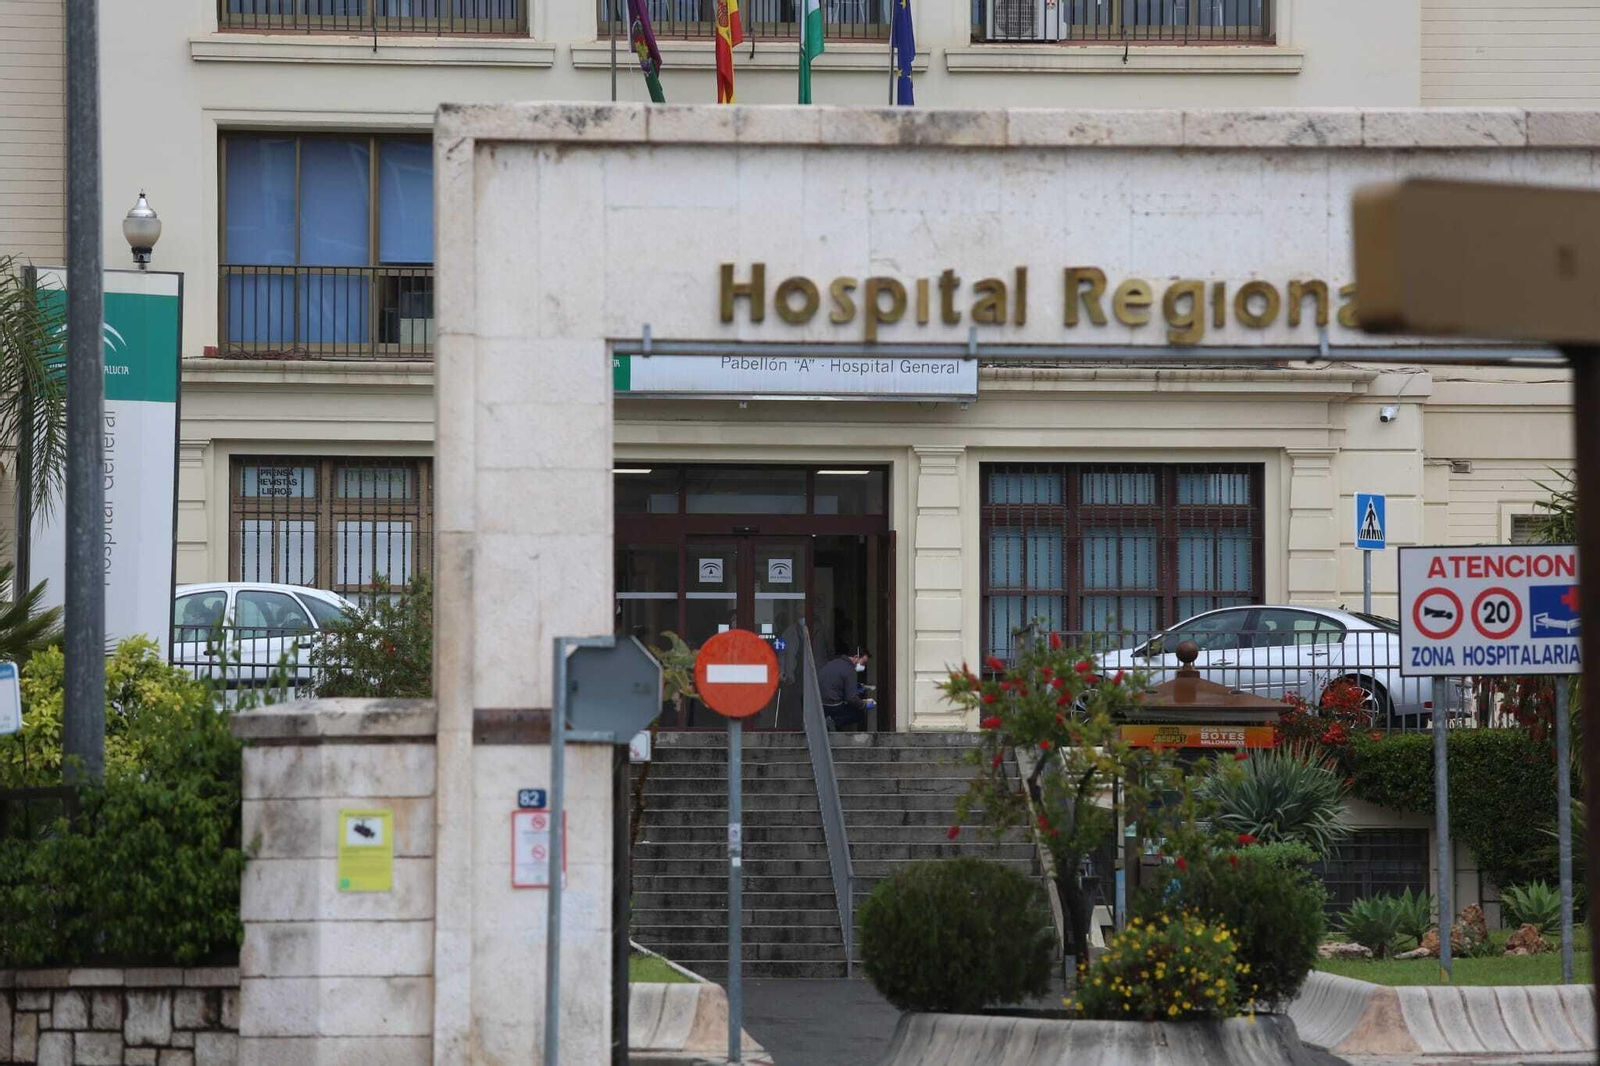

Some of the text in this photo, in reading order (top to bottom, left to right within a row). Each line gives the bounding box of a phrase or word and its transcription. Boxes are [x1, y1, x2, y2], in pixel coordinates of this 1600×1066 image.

[719, 262, 1359, 346] Hospital Regiona
[721, 356, 787, 371] Pabellón
[830, 359, 893, 375] Hospital
[900, 360, 960, 374] General
[349, 469, 401, 481] TENDA
[1427, 554, 1576, 579] ATENCION
[1483, 600, 1510, 624] 20
[1411, 644, 1581, 667] ZONA HOSPITALARIA
[519, 790, 540, 806] 82
